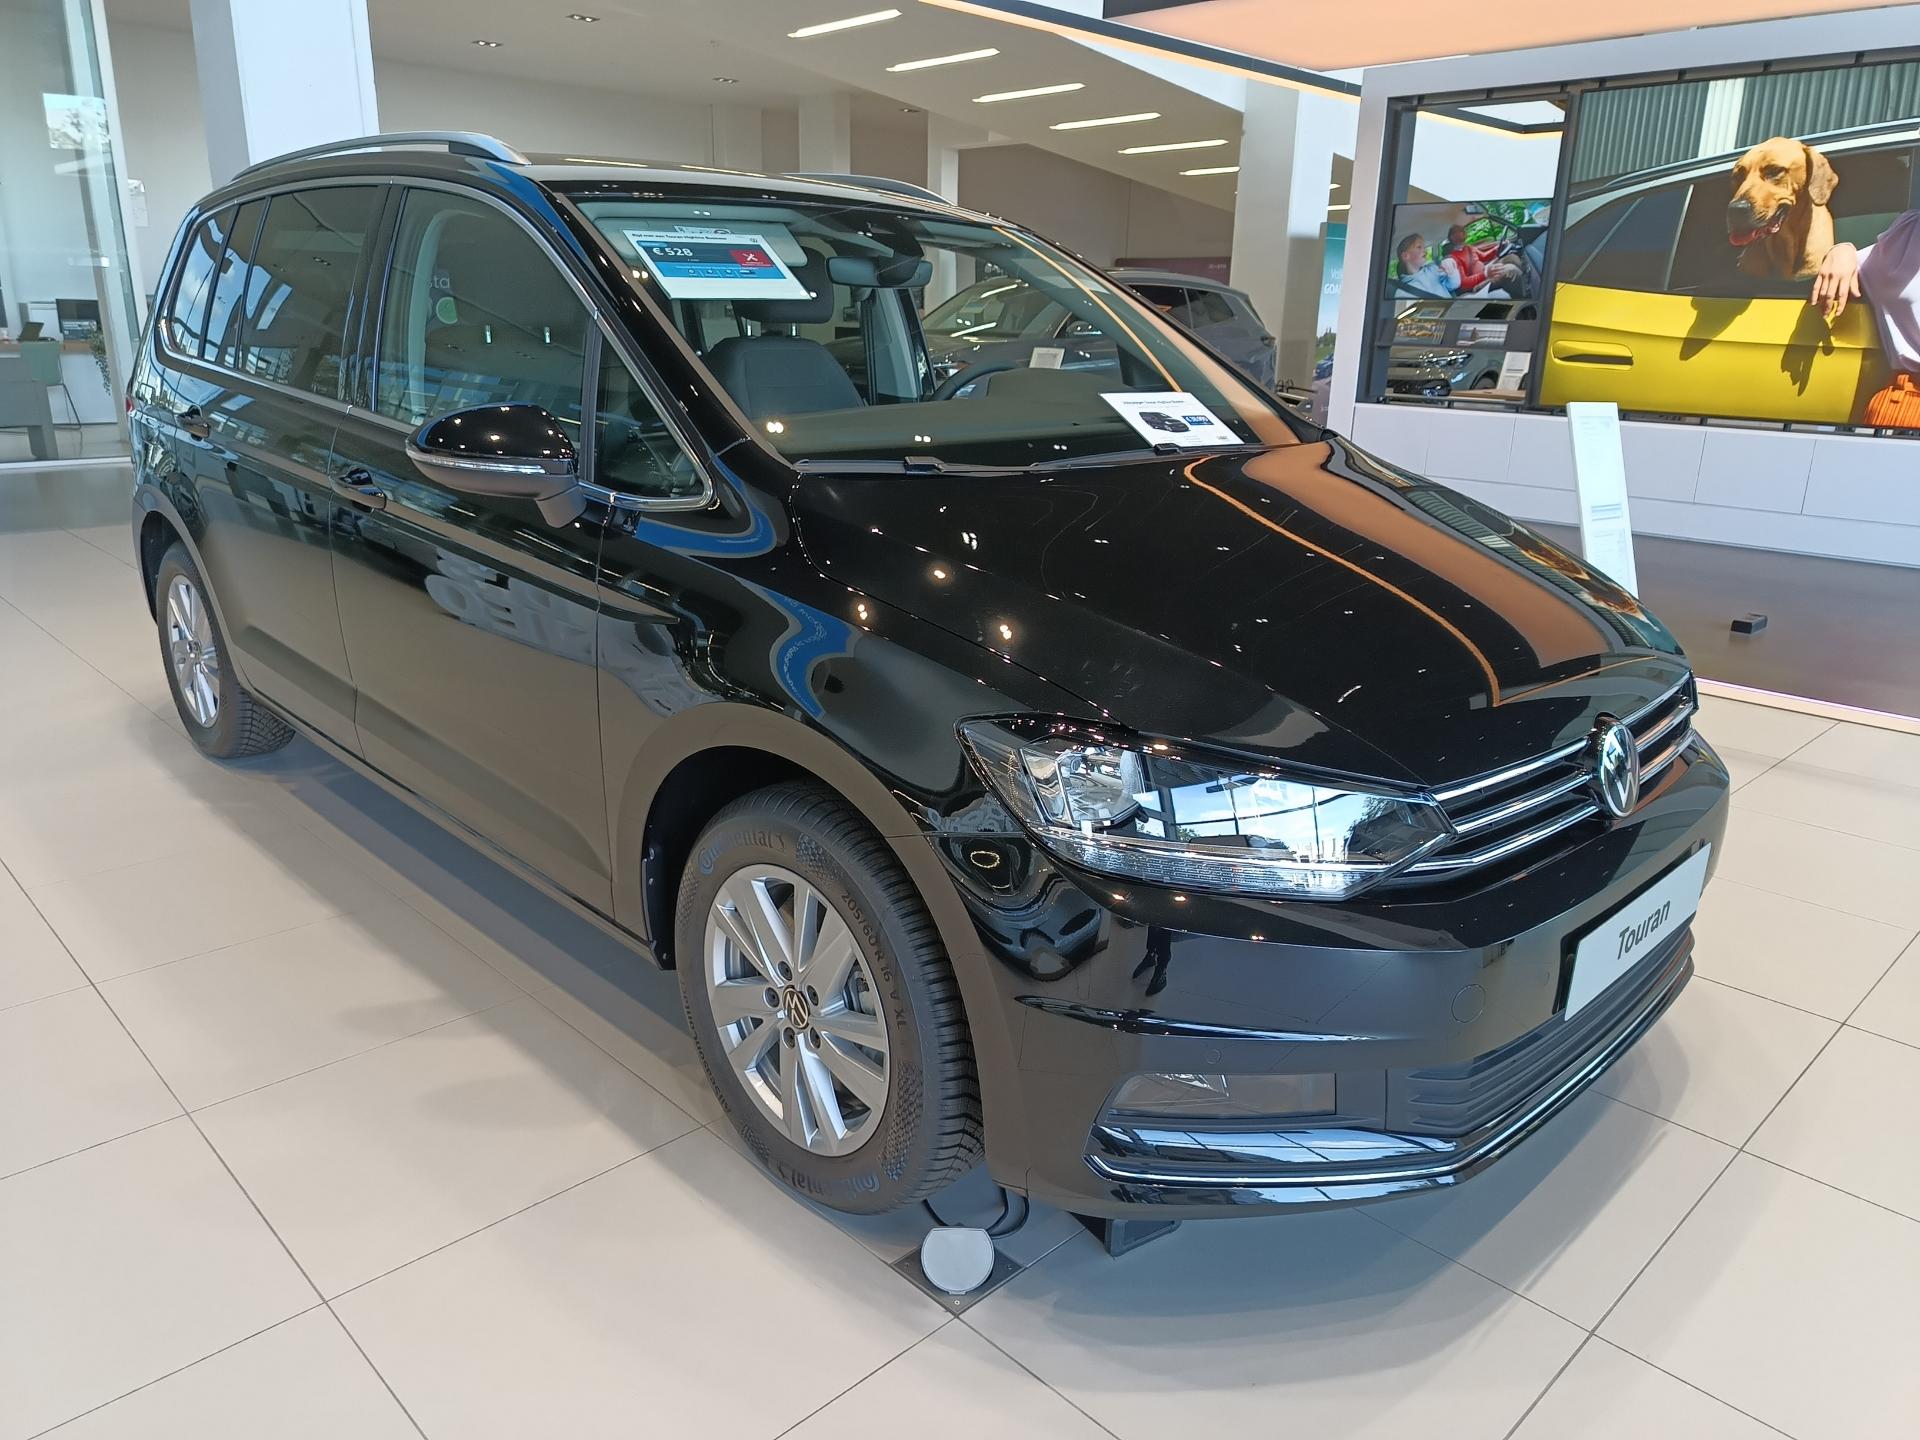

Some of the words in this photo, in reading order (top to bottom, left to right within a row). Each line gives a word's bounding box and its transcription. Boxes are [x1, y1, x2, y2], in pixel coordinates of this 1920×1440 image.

[652, 247, 664, 256] €
[667, 248, 693, 257] 528
[698, 830, 773, 875] Connental
[841, 890, 879, 947] 205/60
[1618, 900, 1671, 960] Touran
